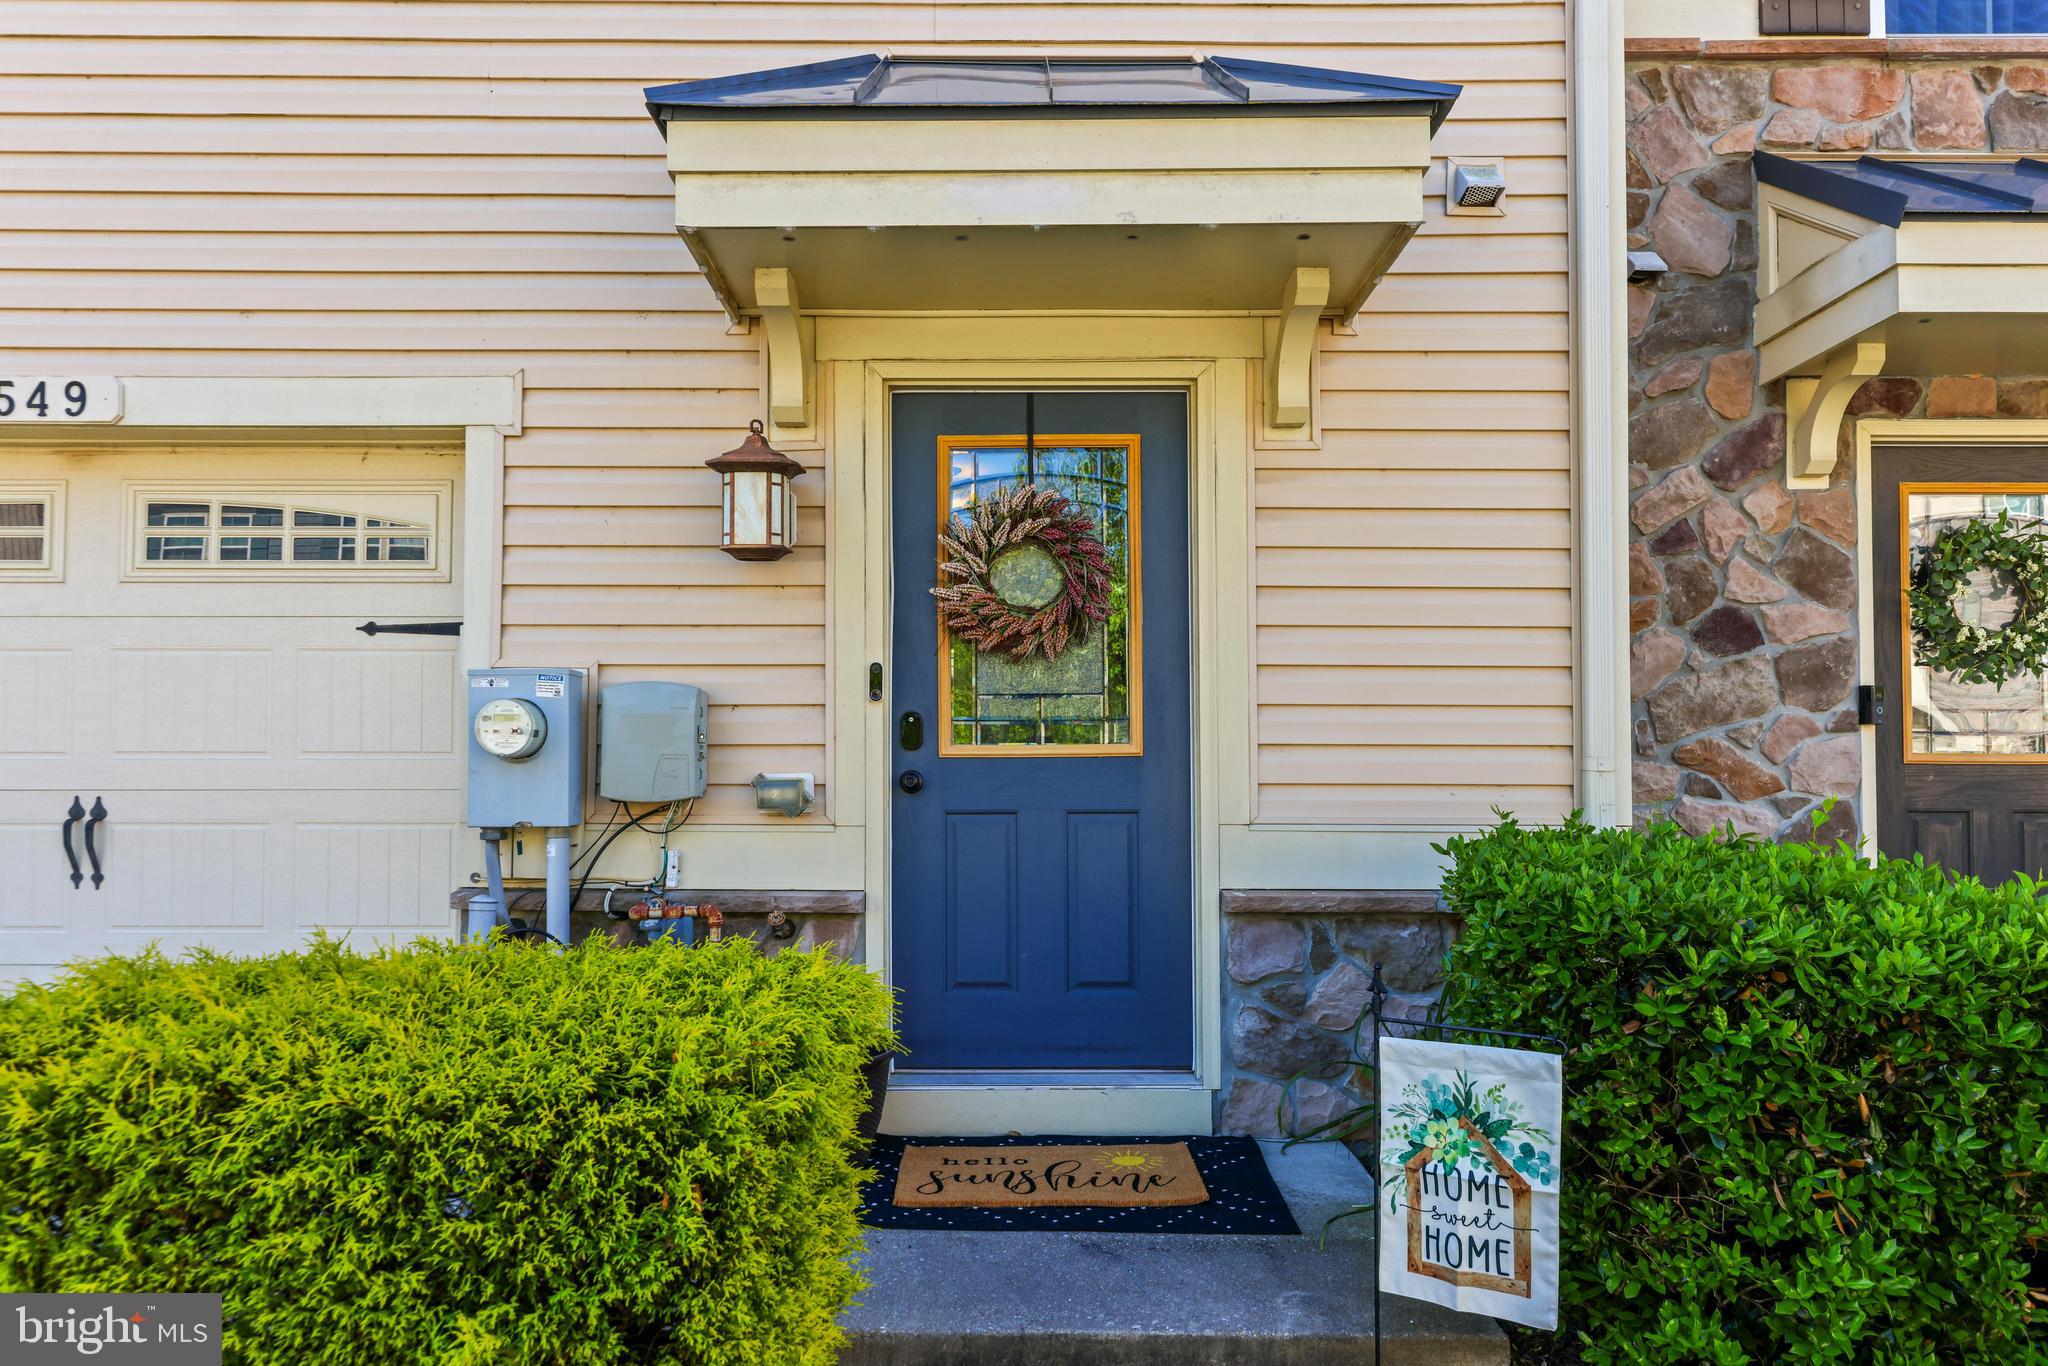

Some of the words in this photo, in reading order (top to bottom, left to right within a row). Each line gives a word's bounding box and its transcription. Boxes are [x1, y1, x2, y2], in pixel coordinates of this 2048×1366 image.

[0, 380, 87, 417] 549
[916, 1160, 1178, 1195] sunshine
[941, 1157, 1029, 1166] hello
[1421, 1162, 1511, 1209] HOME
[1425, 1225, 1511, 1277] HOME
